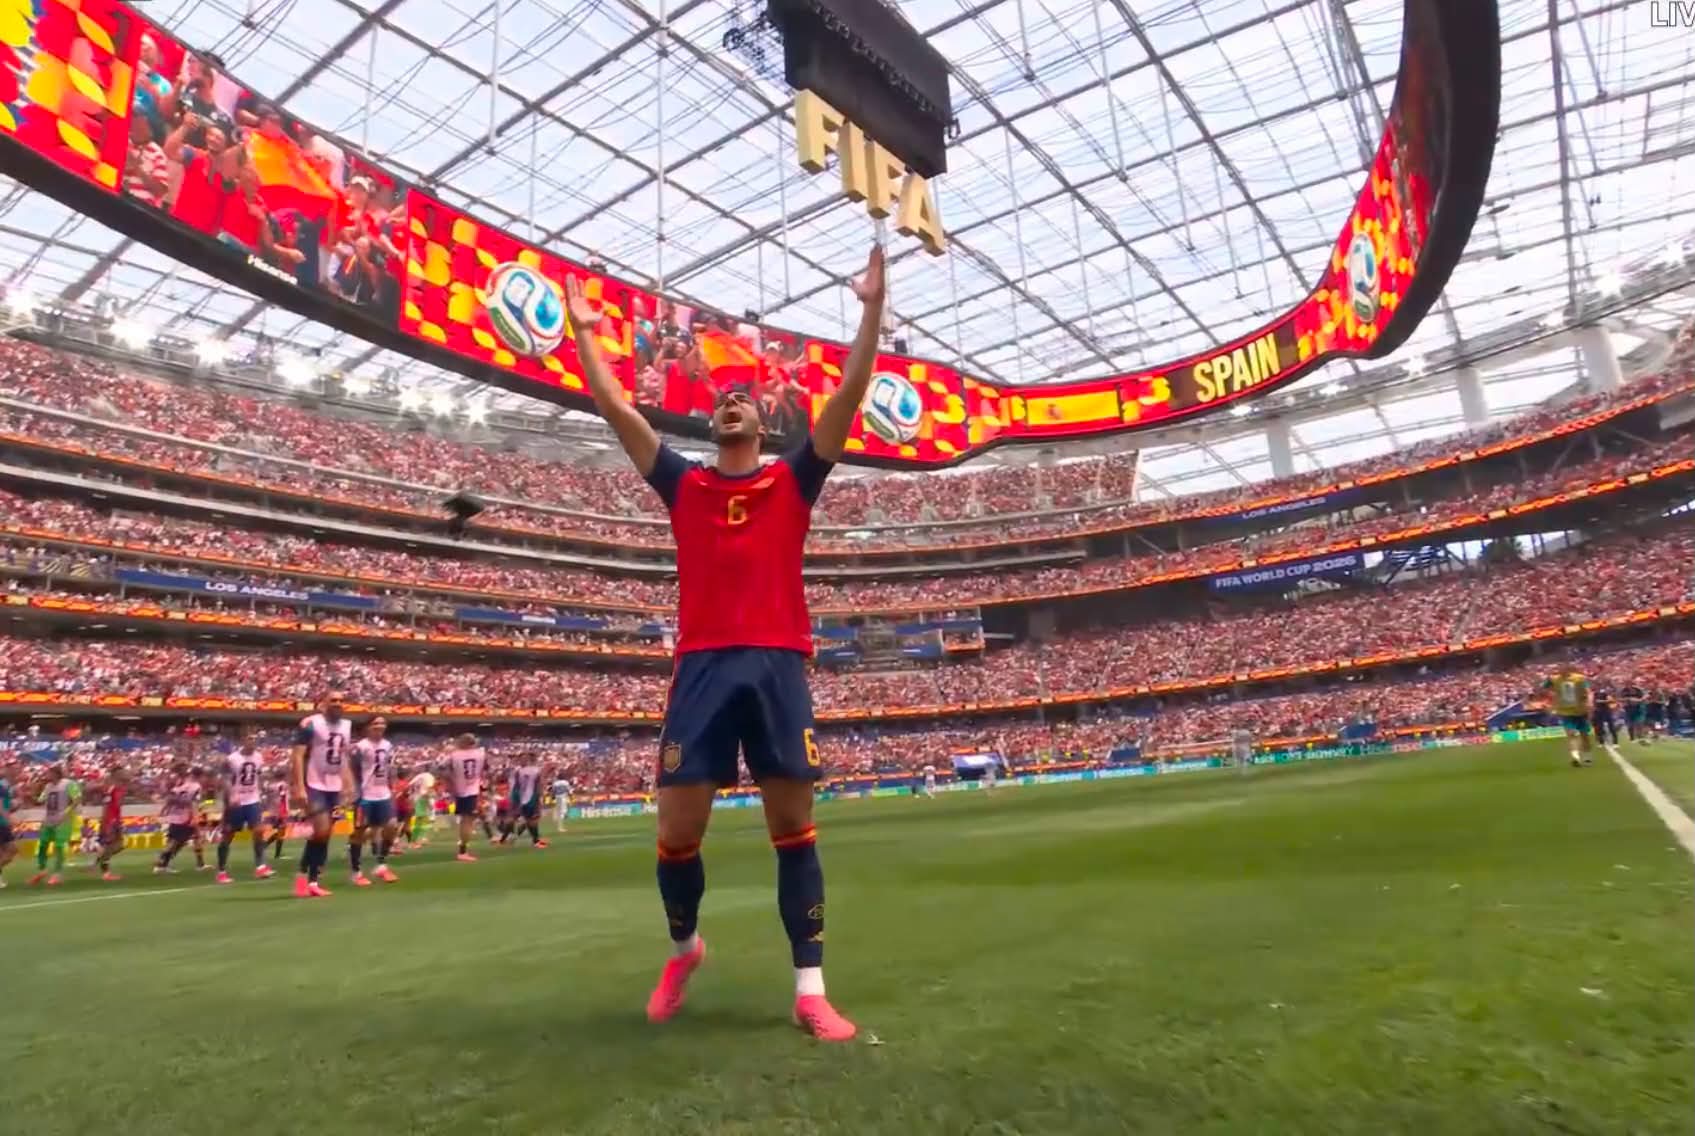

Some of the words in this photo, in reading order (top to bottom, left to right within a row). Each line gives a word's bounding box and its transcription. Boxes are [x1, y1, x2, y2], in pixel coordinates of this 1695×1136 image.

[795, 88, 946, 257] FIFA
[1193, 332, 1280, 402] SPAIN
[727, 495, 748, 525] 6
[1216, 576, 1242, 589] FIFA
[1243, 568, 1286, 585] WORLD
[1286, 563, 1313, 578] CUP
[1312, 555, 1357, 573] 2026
[205, 581, 238, 593] LOS
[240, 585, 309, 600] ANGELES
[803, 728, 820, 766] 6
